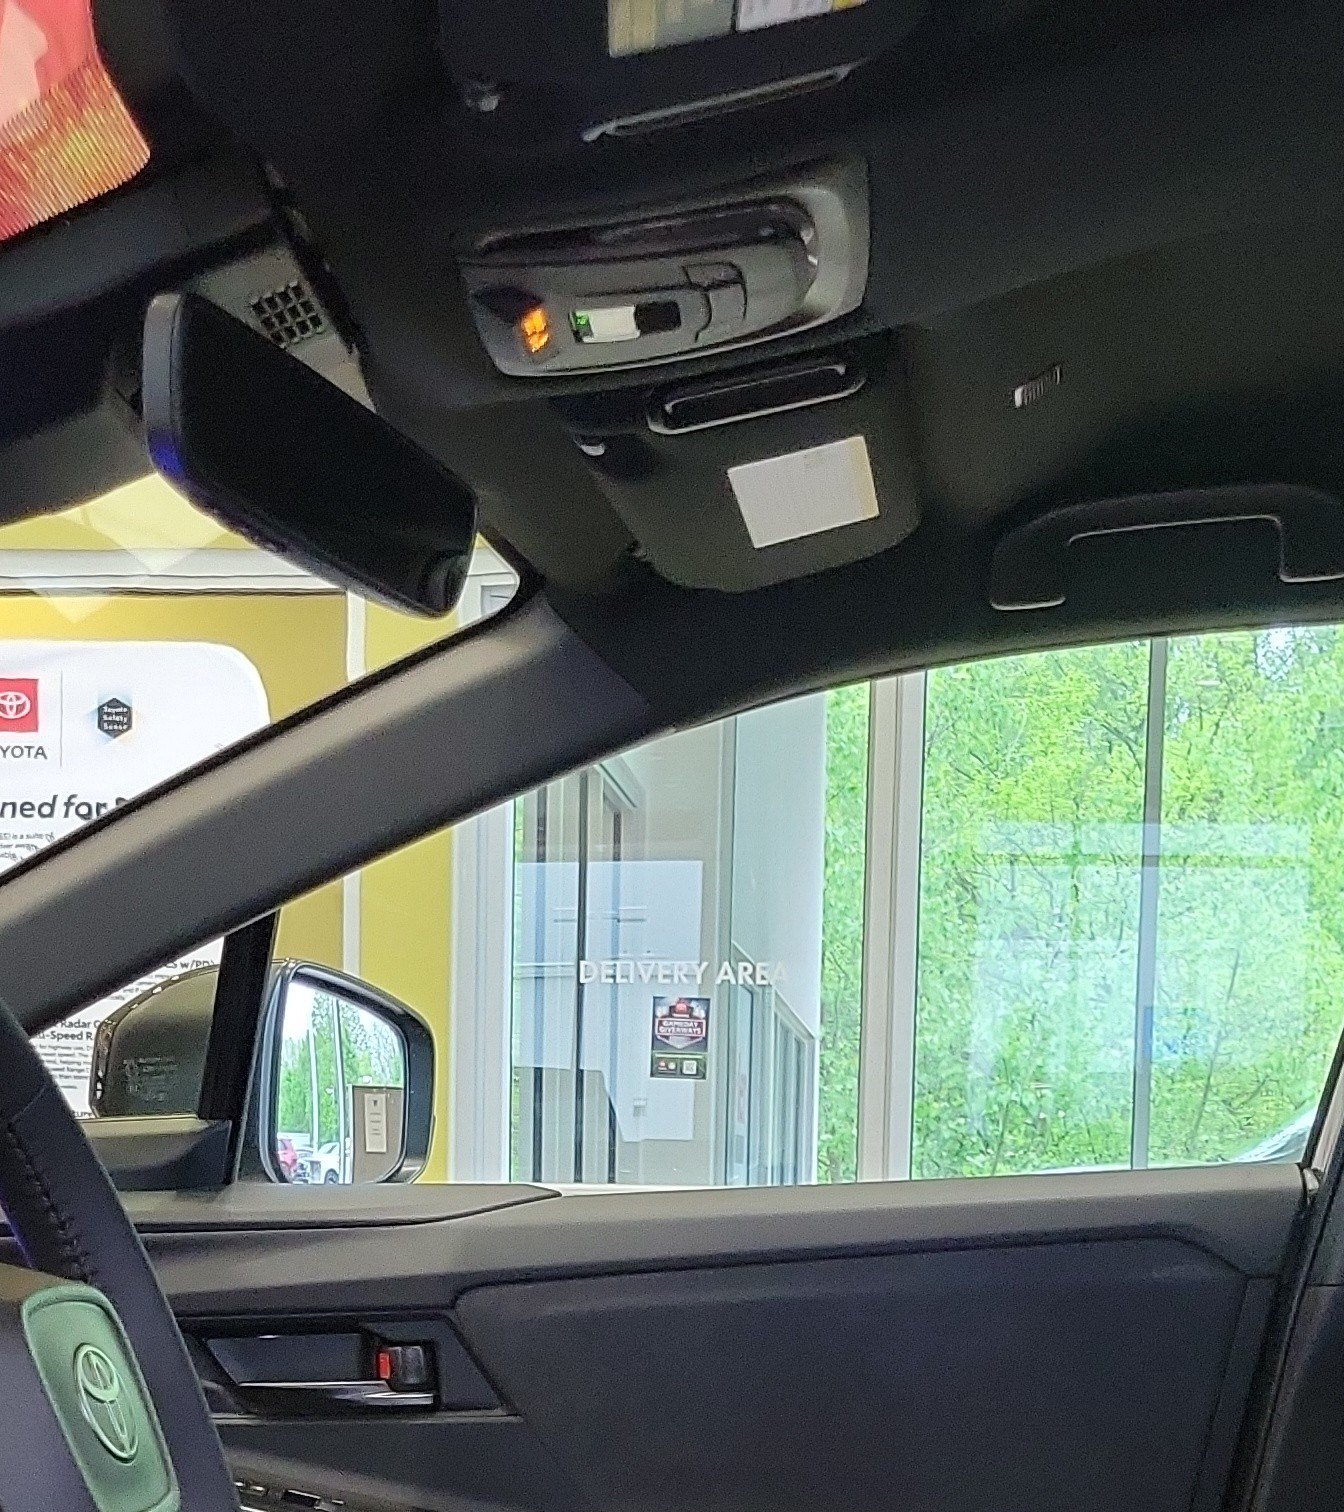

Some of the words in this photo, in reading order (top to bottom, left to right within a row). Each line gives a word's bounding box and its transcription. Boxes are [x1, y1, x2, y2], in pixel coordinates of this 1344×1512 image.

[63, 793, 108, 821] for
[579, 960, 709, 984] DELIVERY
[715, 961, 787, 986] AREA
[61, 1018, 92, 1029] Radar
